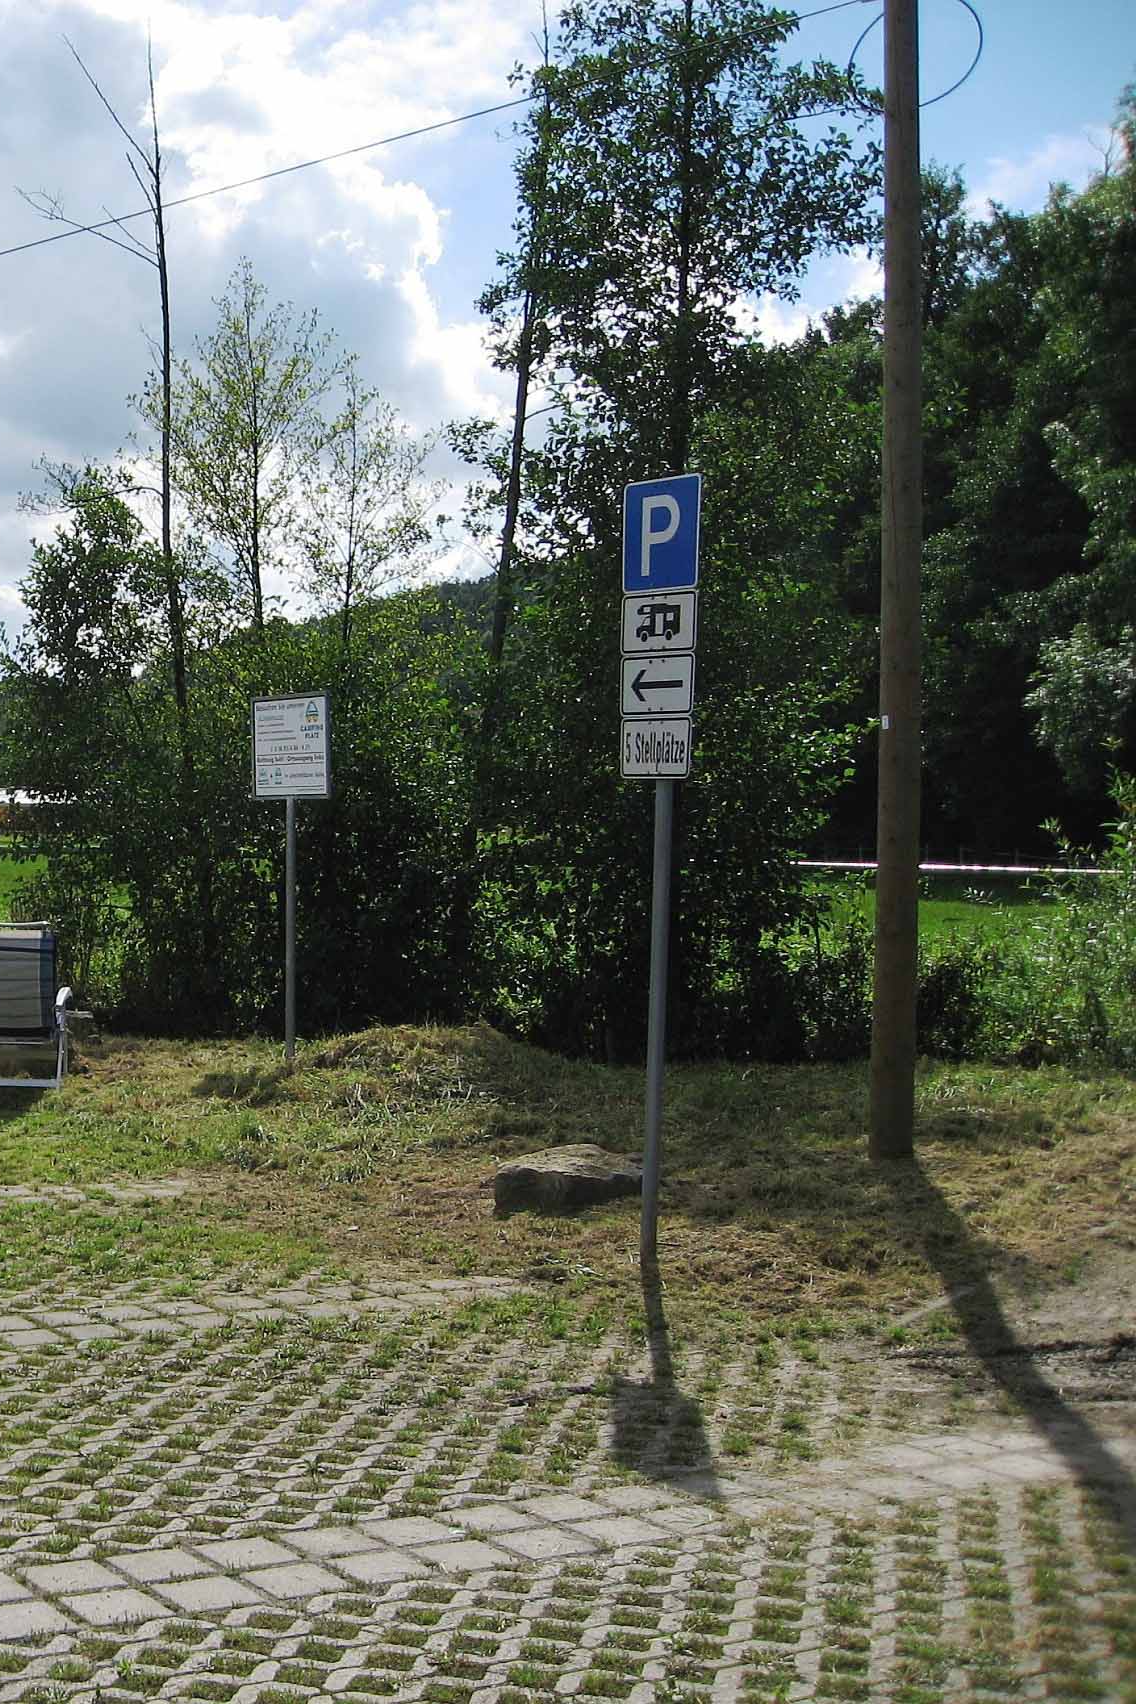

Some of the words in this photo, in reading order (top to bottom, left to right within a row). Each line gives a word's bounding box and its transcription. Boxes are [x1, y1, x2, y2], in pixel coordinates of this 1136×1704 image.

[641, 494, 680, 577] P
[625, 732, 631, 763] 5
[635, 731, 684, 772] Stellplätze
